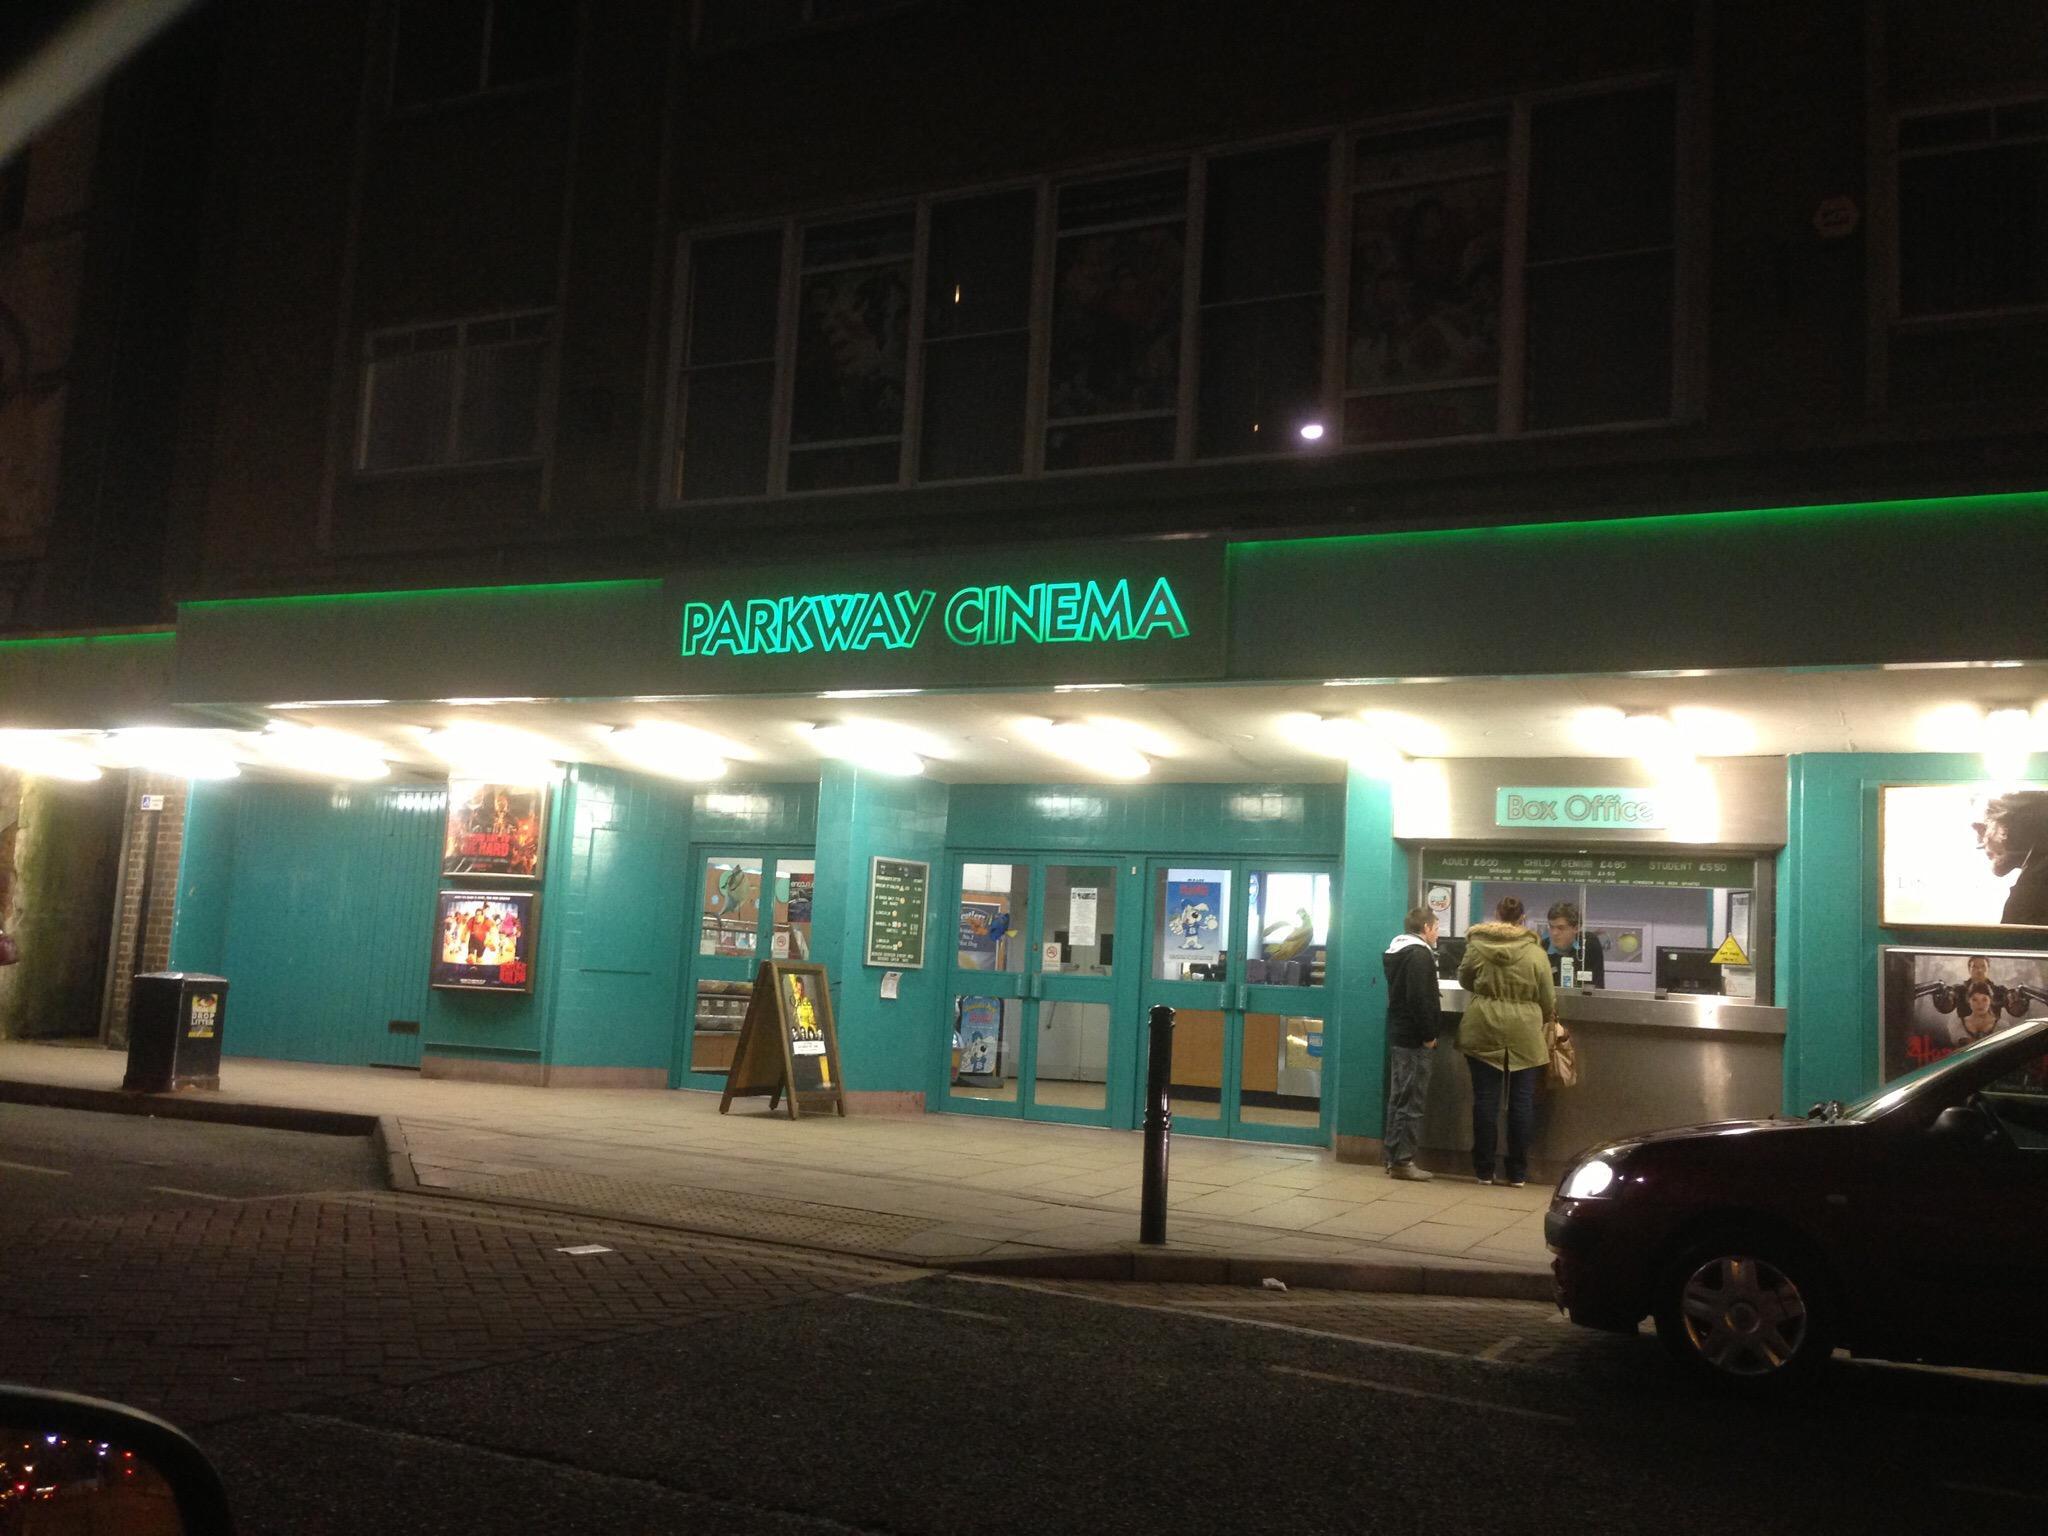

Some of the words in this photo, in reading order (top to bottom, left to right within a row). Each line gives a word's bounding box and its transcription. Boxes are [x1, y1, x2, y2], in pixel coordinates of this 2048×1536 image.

[682, 590, 936, 655] PARKWAY
[945, 577, 1189, 645] CINEMA
[1507, 794, 1558, 820] Box
[1564, 794, 1654, 823] Office
[1442, 857, 1469, 866] ADULT
[1523, 858, 1551, 867] CHILD
[1649, 861, 1693, 871] STUDENT
